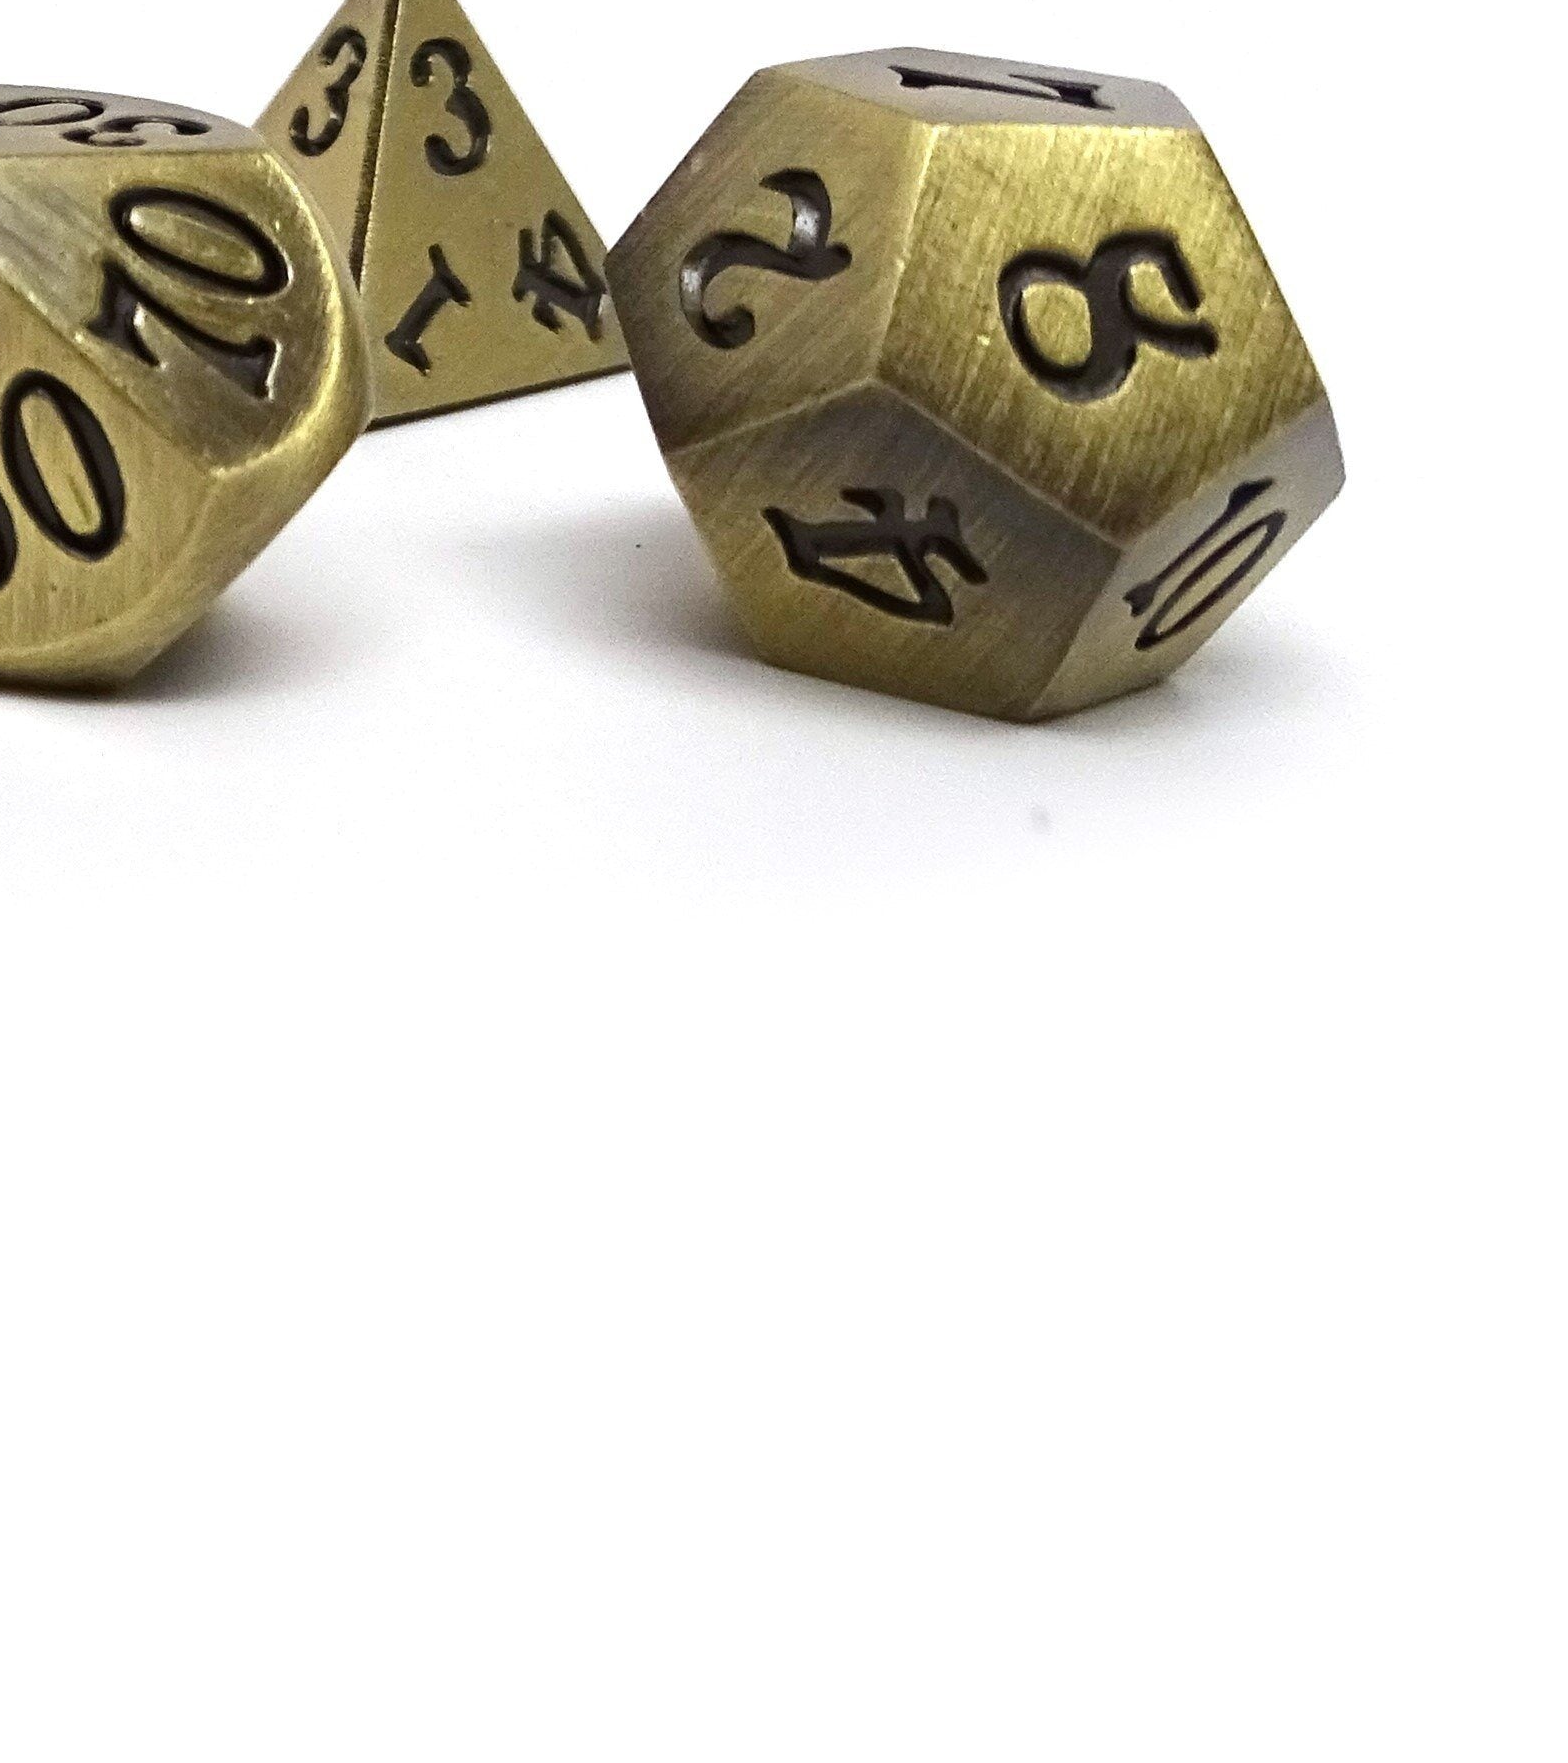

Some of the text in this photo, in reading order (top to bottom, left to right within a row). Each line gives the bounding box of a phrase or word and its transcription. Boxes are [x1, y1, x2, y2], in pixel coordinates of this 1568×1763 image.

[290, 24, 366, 157] 3
[410, 38, 491, 176] 3
[75, 185, 293, 401] 70
[384, 244, 472, 377] 1
[512, 210, 607, 341] 4
[680, 168, 853, 349] 2
[997, 228, 1219, 402] 8
[763, 488, 987, 626] 4
[1124, 477, 1285, 651] 10
